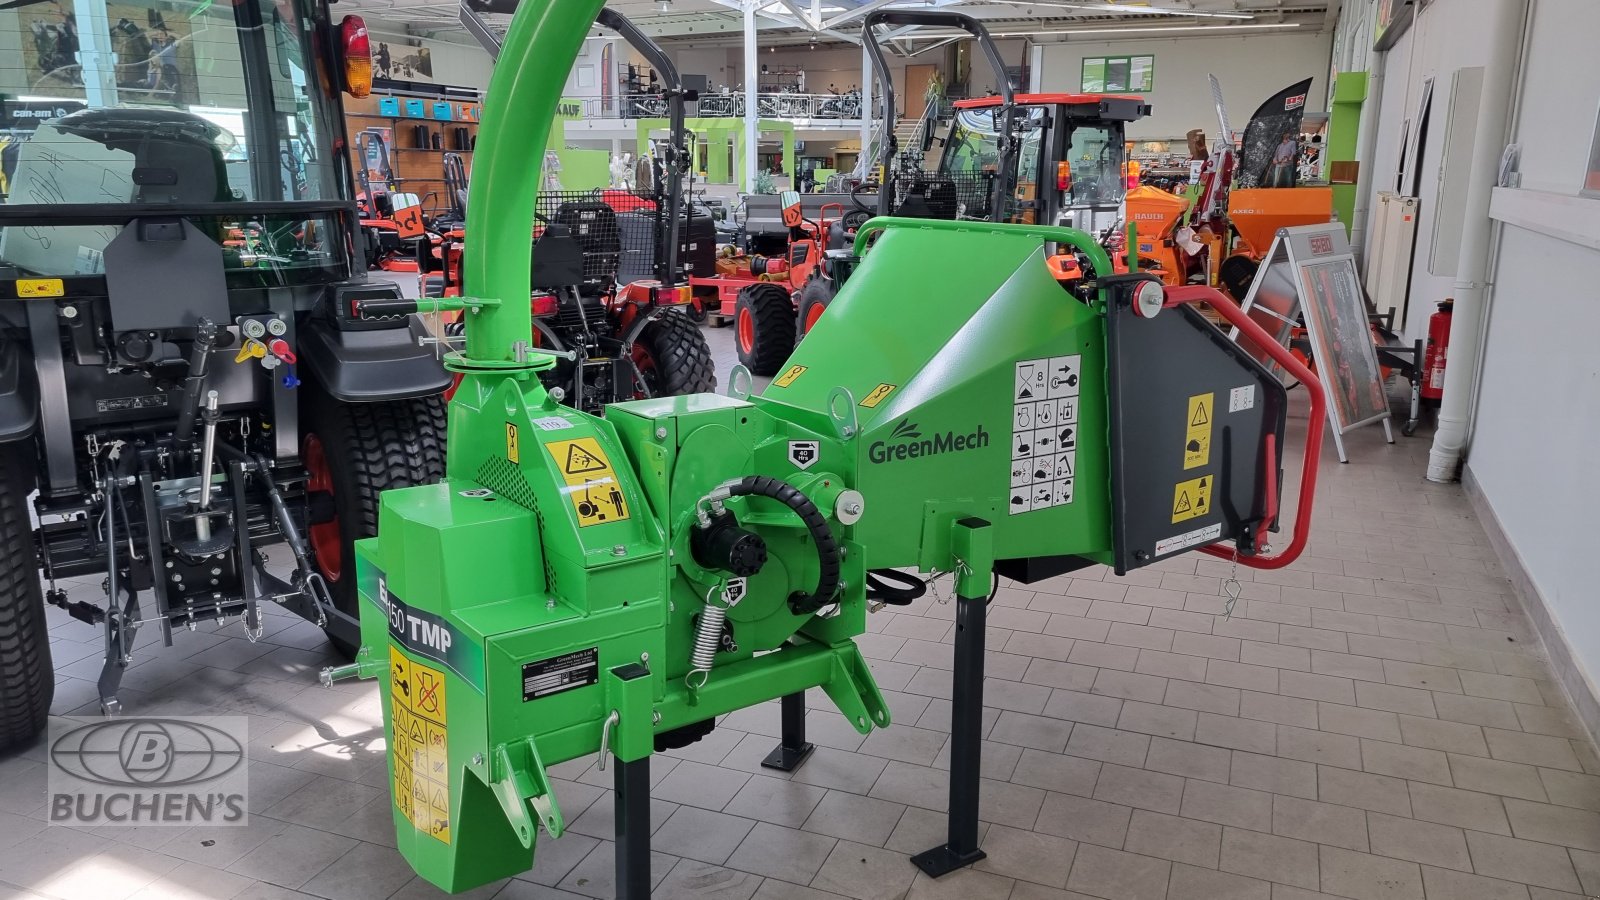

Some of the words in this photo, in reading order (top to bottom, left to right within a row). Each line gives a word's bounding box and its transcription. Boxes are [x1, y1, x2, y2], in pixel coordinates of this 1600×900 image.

[13, 110, 52, 118] can-am
[1311, 236, 1332, 253] SABO
[1037, 371, 1043, 381] 8
[868, 424, 989, 464] GreenMech
[388, 600, 405, 633] 150
[406, 614, 452, 653] TMP
